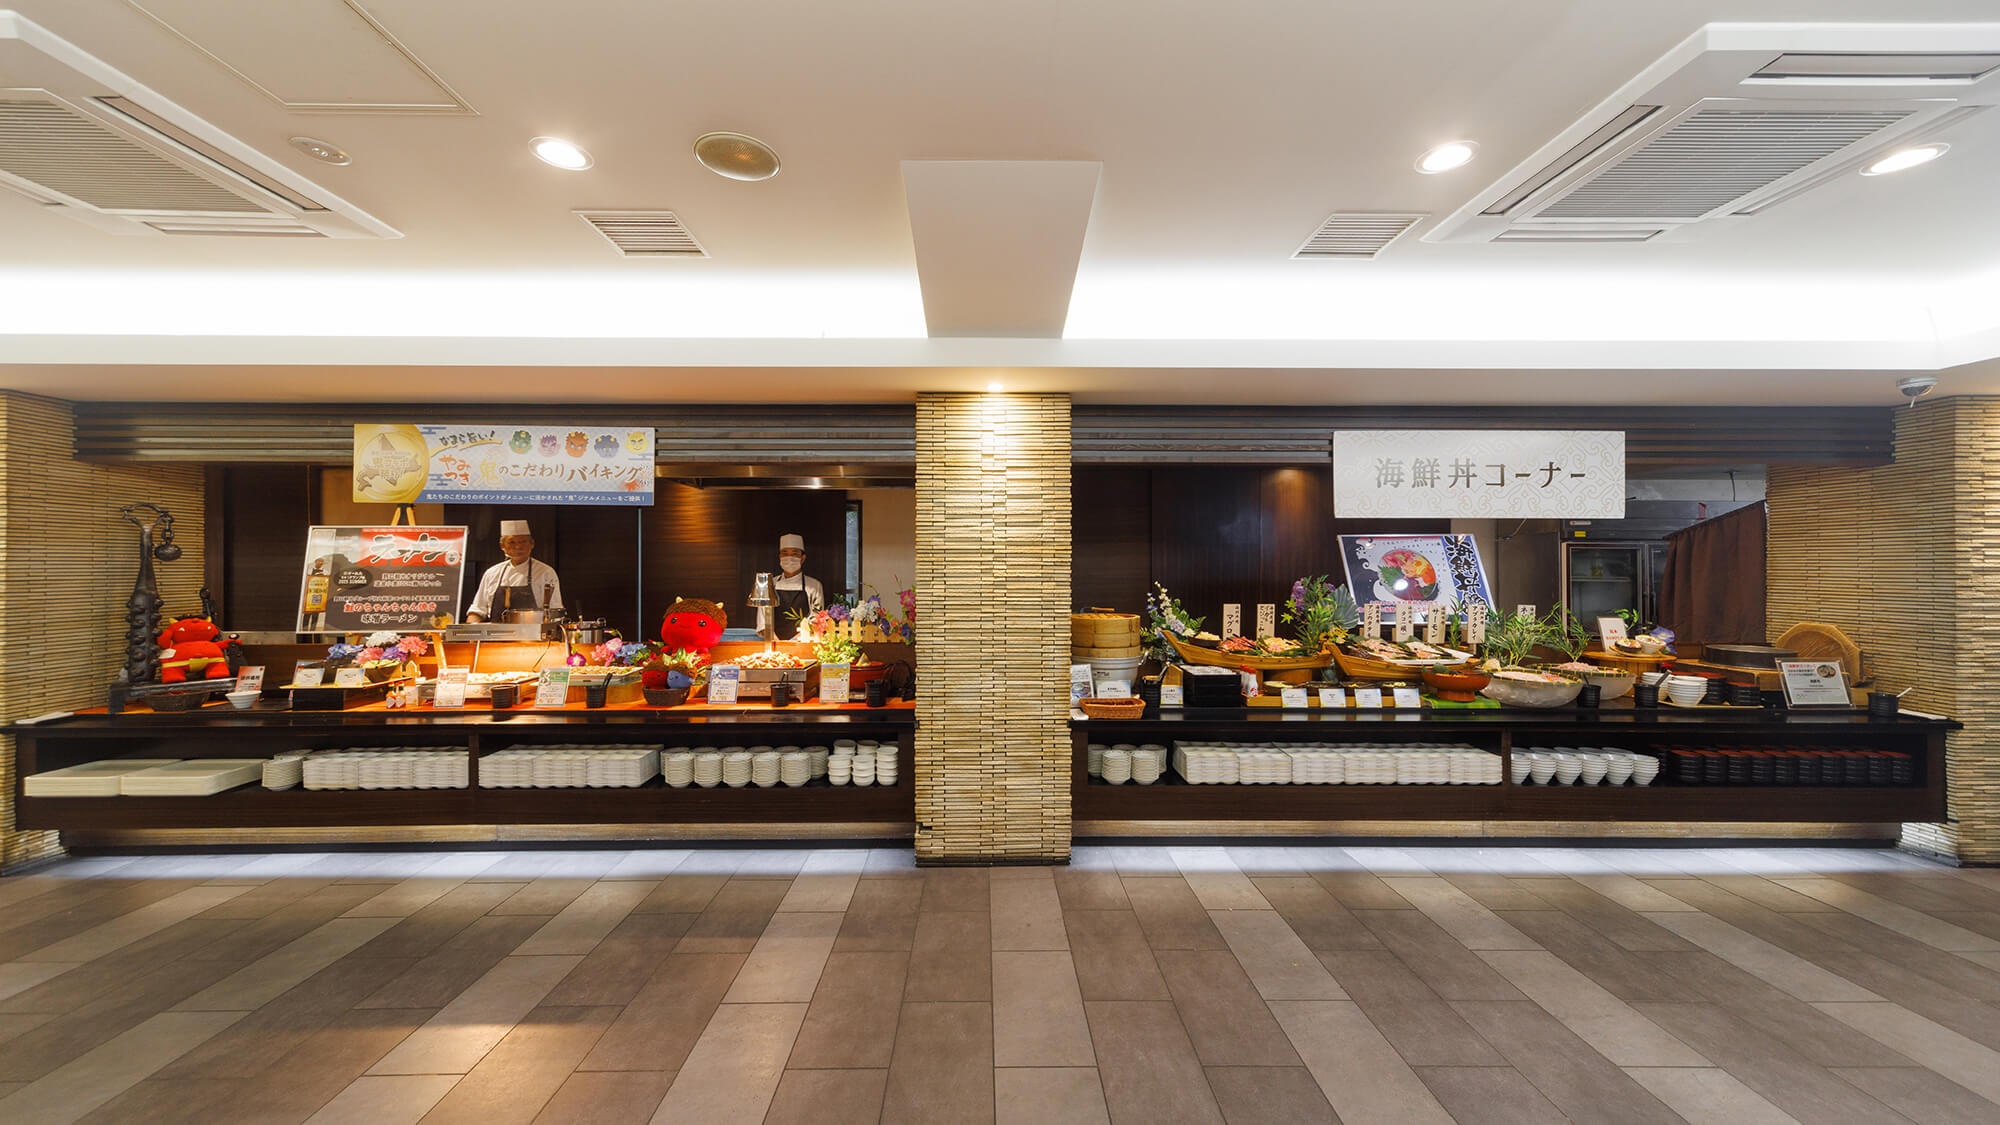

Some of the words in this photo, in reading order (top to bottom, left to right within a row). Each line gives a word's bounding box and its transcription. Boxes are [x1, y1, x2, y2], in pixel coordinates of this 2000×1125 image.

[1374, 457, 1586, 489] 海鮮丼コーナー
[1226, 613, 1235, 634] マグロ
[1431, 608, 1439, 639] サーモン
